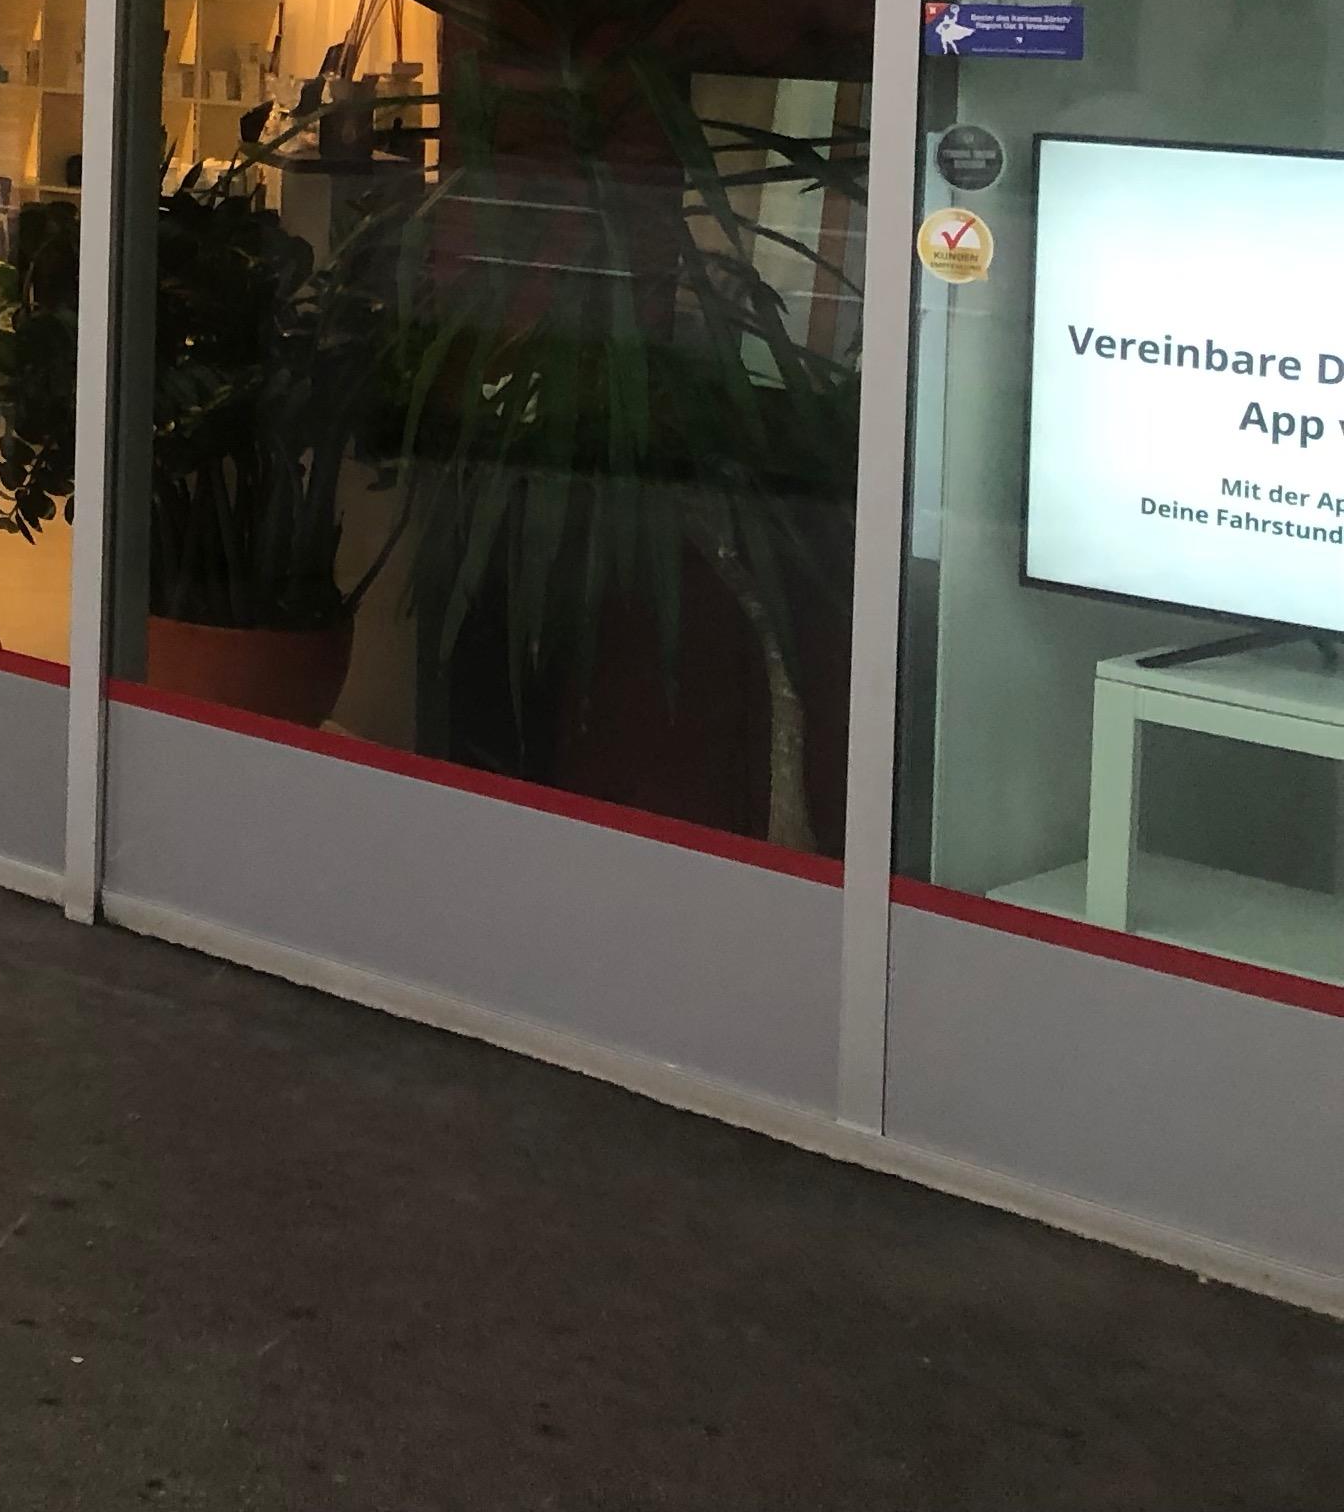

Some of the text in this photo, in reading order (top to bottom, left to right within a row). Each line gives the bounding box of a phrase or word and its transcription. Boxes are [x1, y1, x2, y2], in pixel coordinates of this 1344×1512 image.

[1067, 324, 1302, 380] Vereinbare
[1238, 401, 1325, 448] App
[1221, 477, 1262, 500] Mit
[1268, 484, 1311, 507] der
[1140, 496, 1344, 544] Deine Fahrstund
